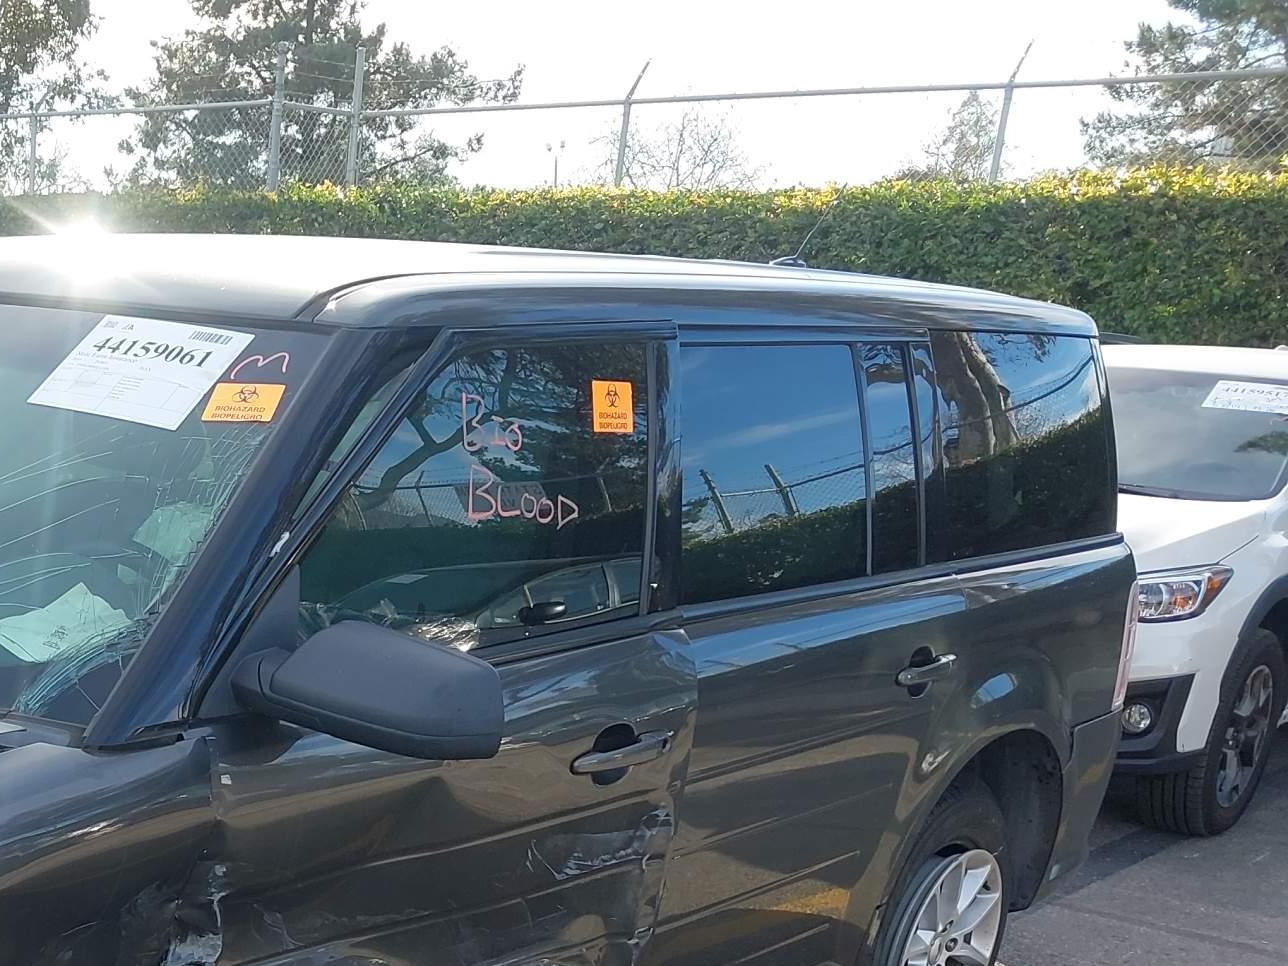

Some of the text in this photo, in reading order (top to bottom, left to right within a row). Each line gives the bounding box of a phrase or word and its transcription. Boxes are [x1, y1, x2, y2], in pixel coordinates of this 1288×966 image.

[93, 336, 213, 368] 44159061
[210, 412, 263, 420] BIOPELIGRO
[214, 405, 266, 413] BIOHAZARD
[467, 464, 579, 531] BLOOD
